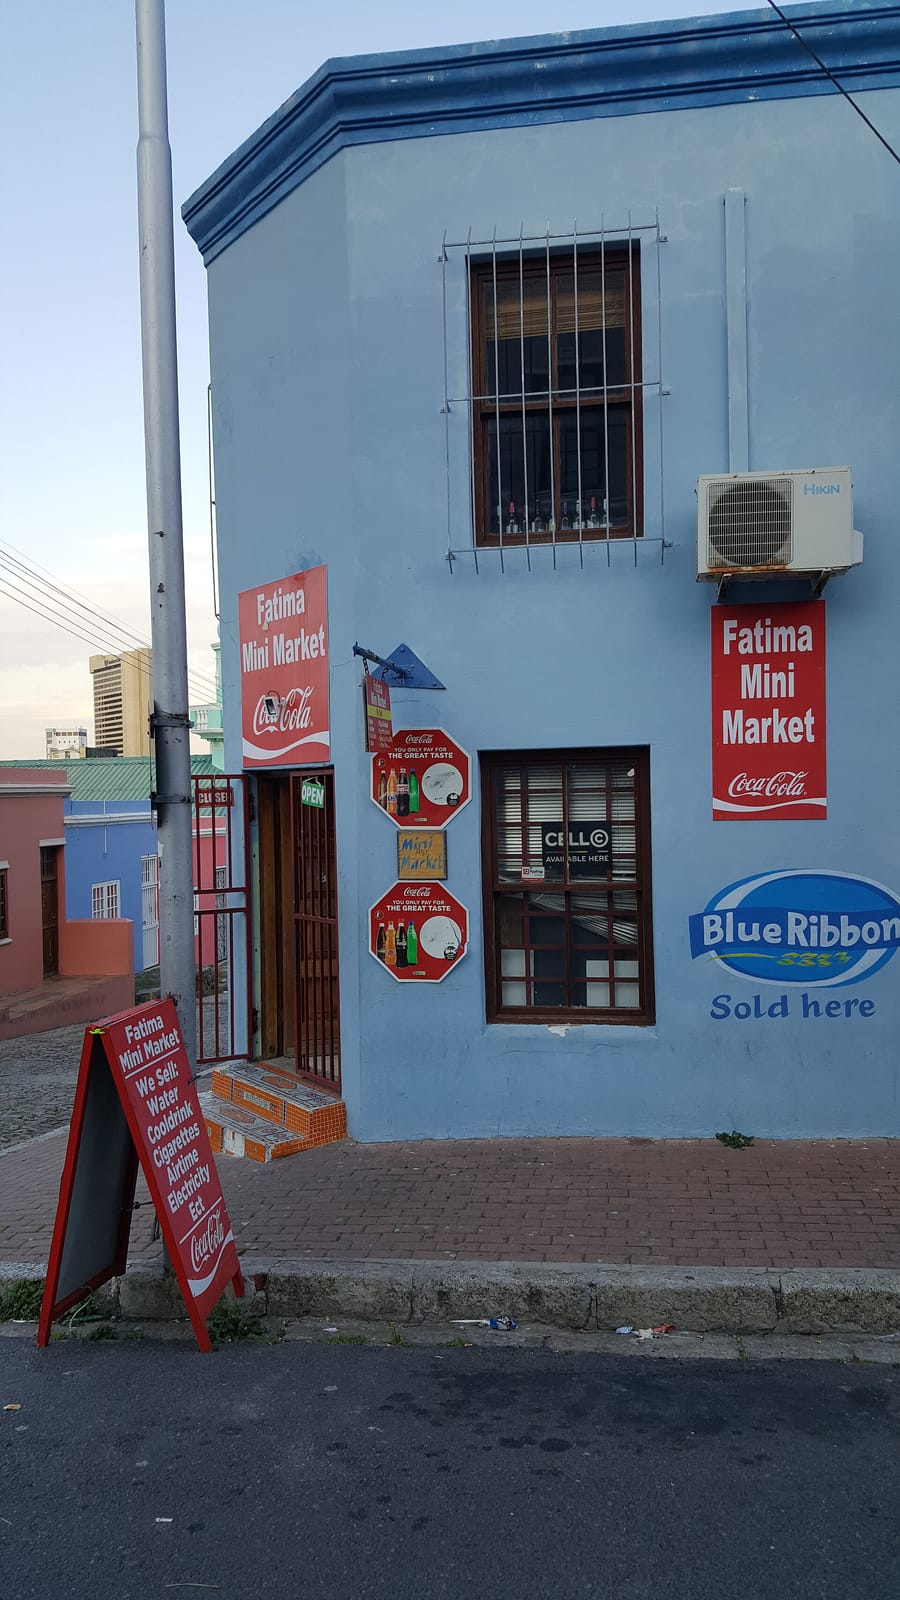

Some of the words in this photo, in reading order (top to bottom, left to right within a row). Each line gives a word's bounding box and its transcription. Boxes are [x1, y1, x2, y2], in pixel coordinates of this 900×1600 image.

[256, 587, 306, 626] Fatima
[242, 637, 269, 673] Mini
[272, 624, 326, 666] Market
[723, 618, 813, 656] Fatima
[740, 662, 795, 700] Mini
[252, 686, 314, 736] CoCola
[722, 707, 815, 746] Market
[301, 784, 324, 805] OPEN
[727, 770, 809, 798] Coca-Cola
[402, 835, 433, 850] Mini
[545, 855, 588, 863] AVAIABLE
[702, 911, 783, 946] Blue
[787, 911, 900, 949] Ribbon
[710, 993, 791, 1020] Sold
[802, 993, 877, 1019] here
[124, 1012, 165, 1044] Fatima
[118, 1047, 144, 1073] Mini
[143, 1026, 180, 1060] Market
[135, 1074, 156, 1099] We
[155, 1059, 180, 1087] Sell:
[146, 1088, 179, 1117] Water
[147, 1100, 194, 1145] Cooldrink
[153, 1123, 201, 1169] Cigarettes
[167, 1148, 200, 1186] Airtime
[167, 1164, 212, 1214] Electricity
[187, 1199, 204, 1223] Ect
[191, 1210, 226, 1272] Coca-Cola
